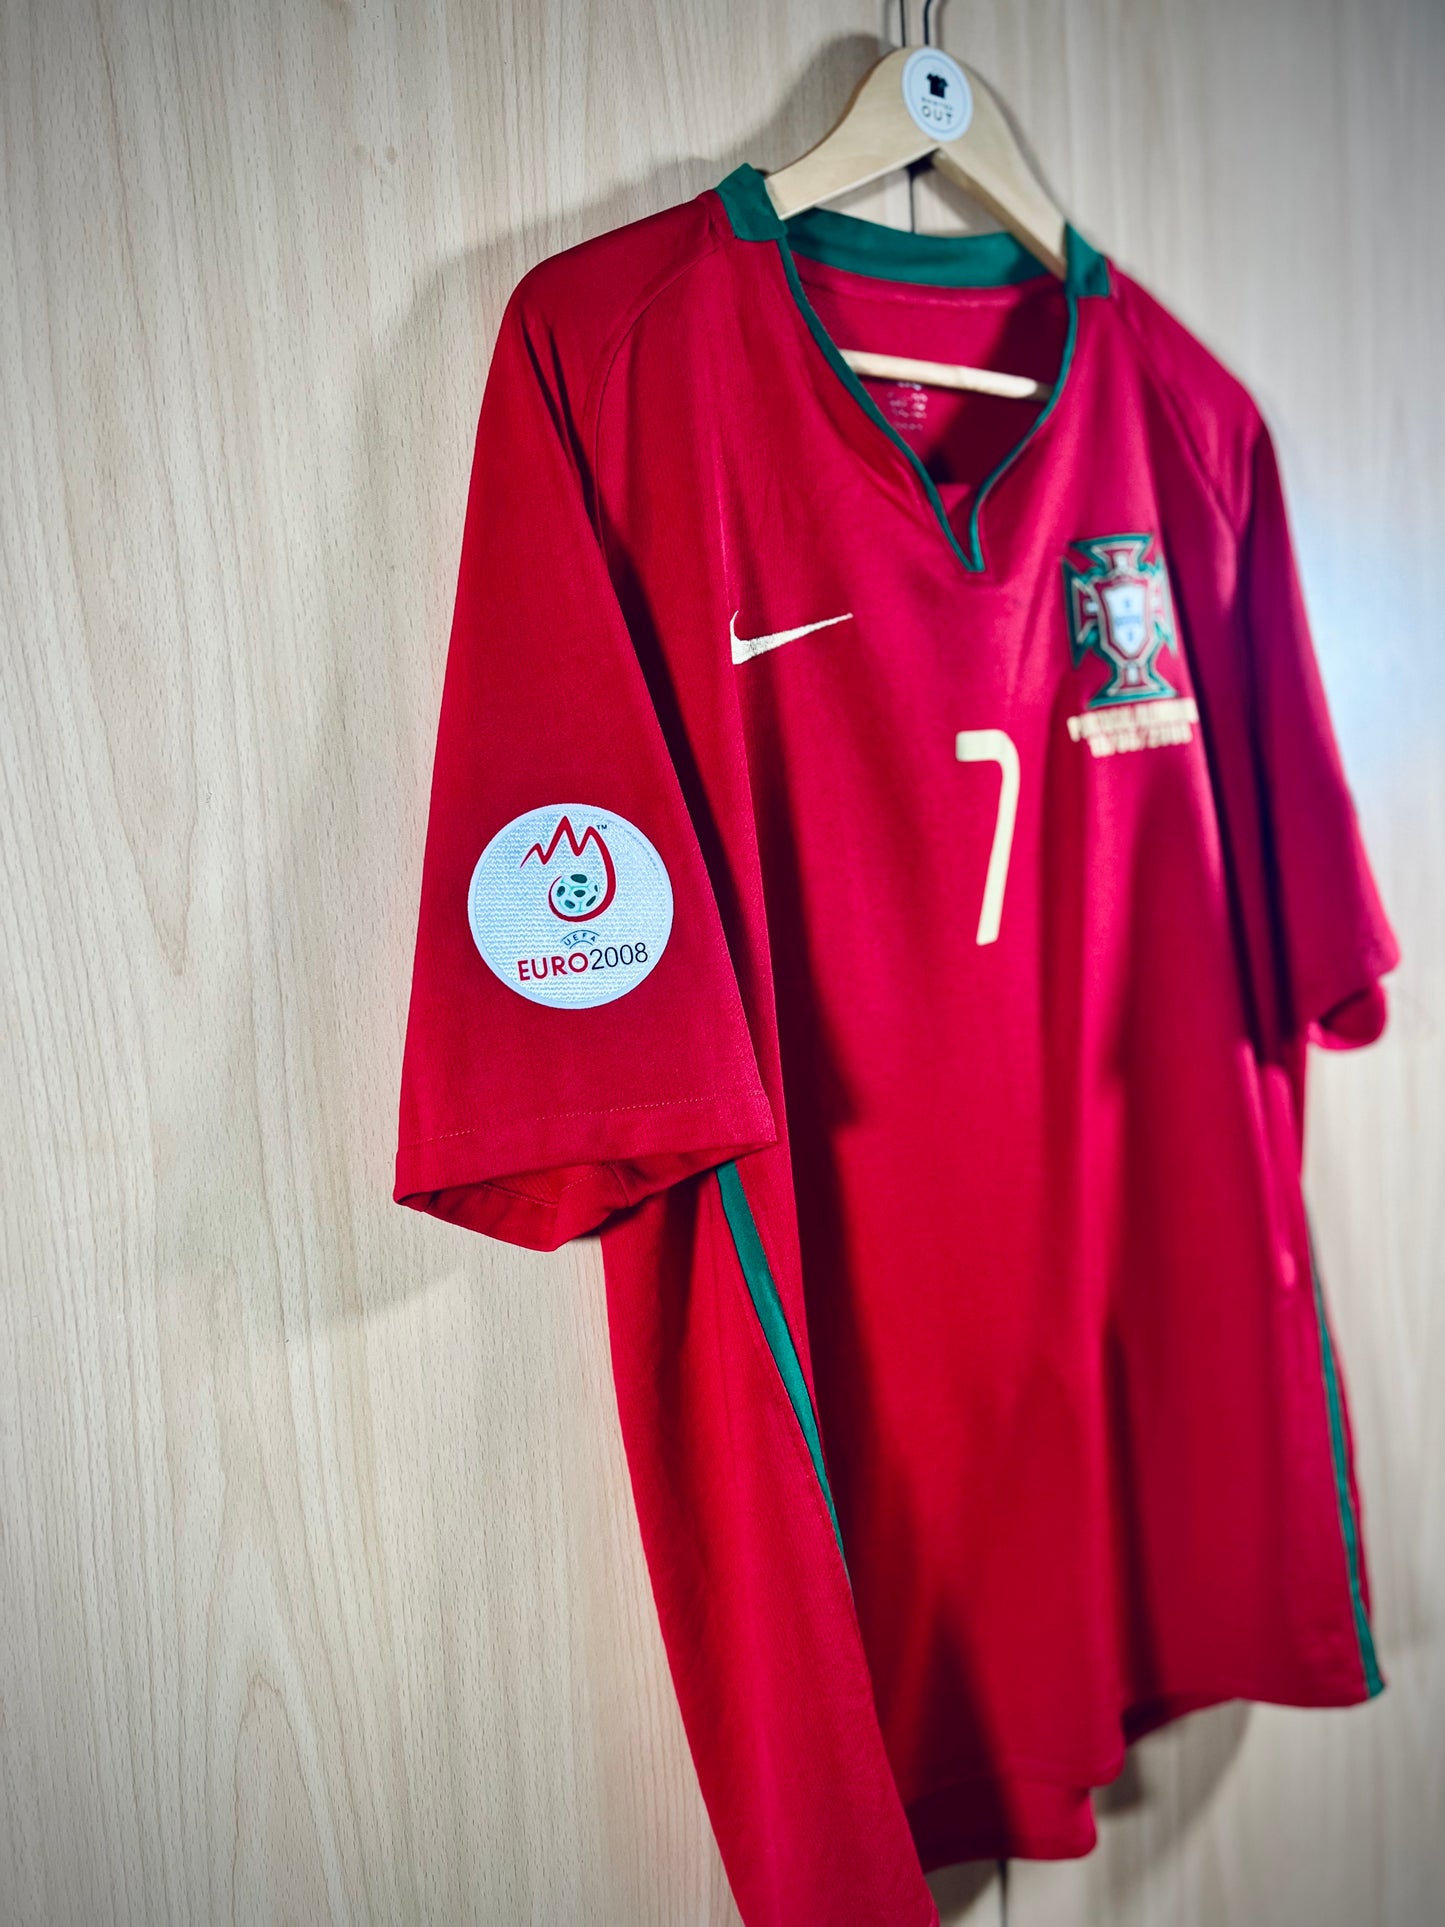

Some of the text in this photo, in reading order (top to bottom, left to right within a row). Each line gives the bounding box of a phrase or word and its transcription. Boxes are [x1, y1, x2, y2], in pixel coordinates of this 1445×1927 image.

[922, 105, 952, 125] OUT
[956, 729, 1021, 946] 7
[563, 932, 596, 946] UEFA
